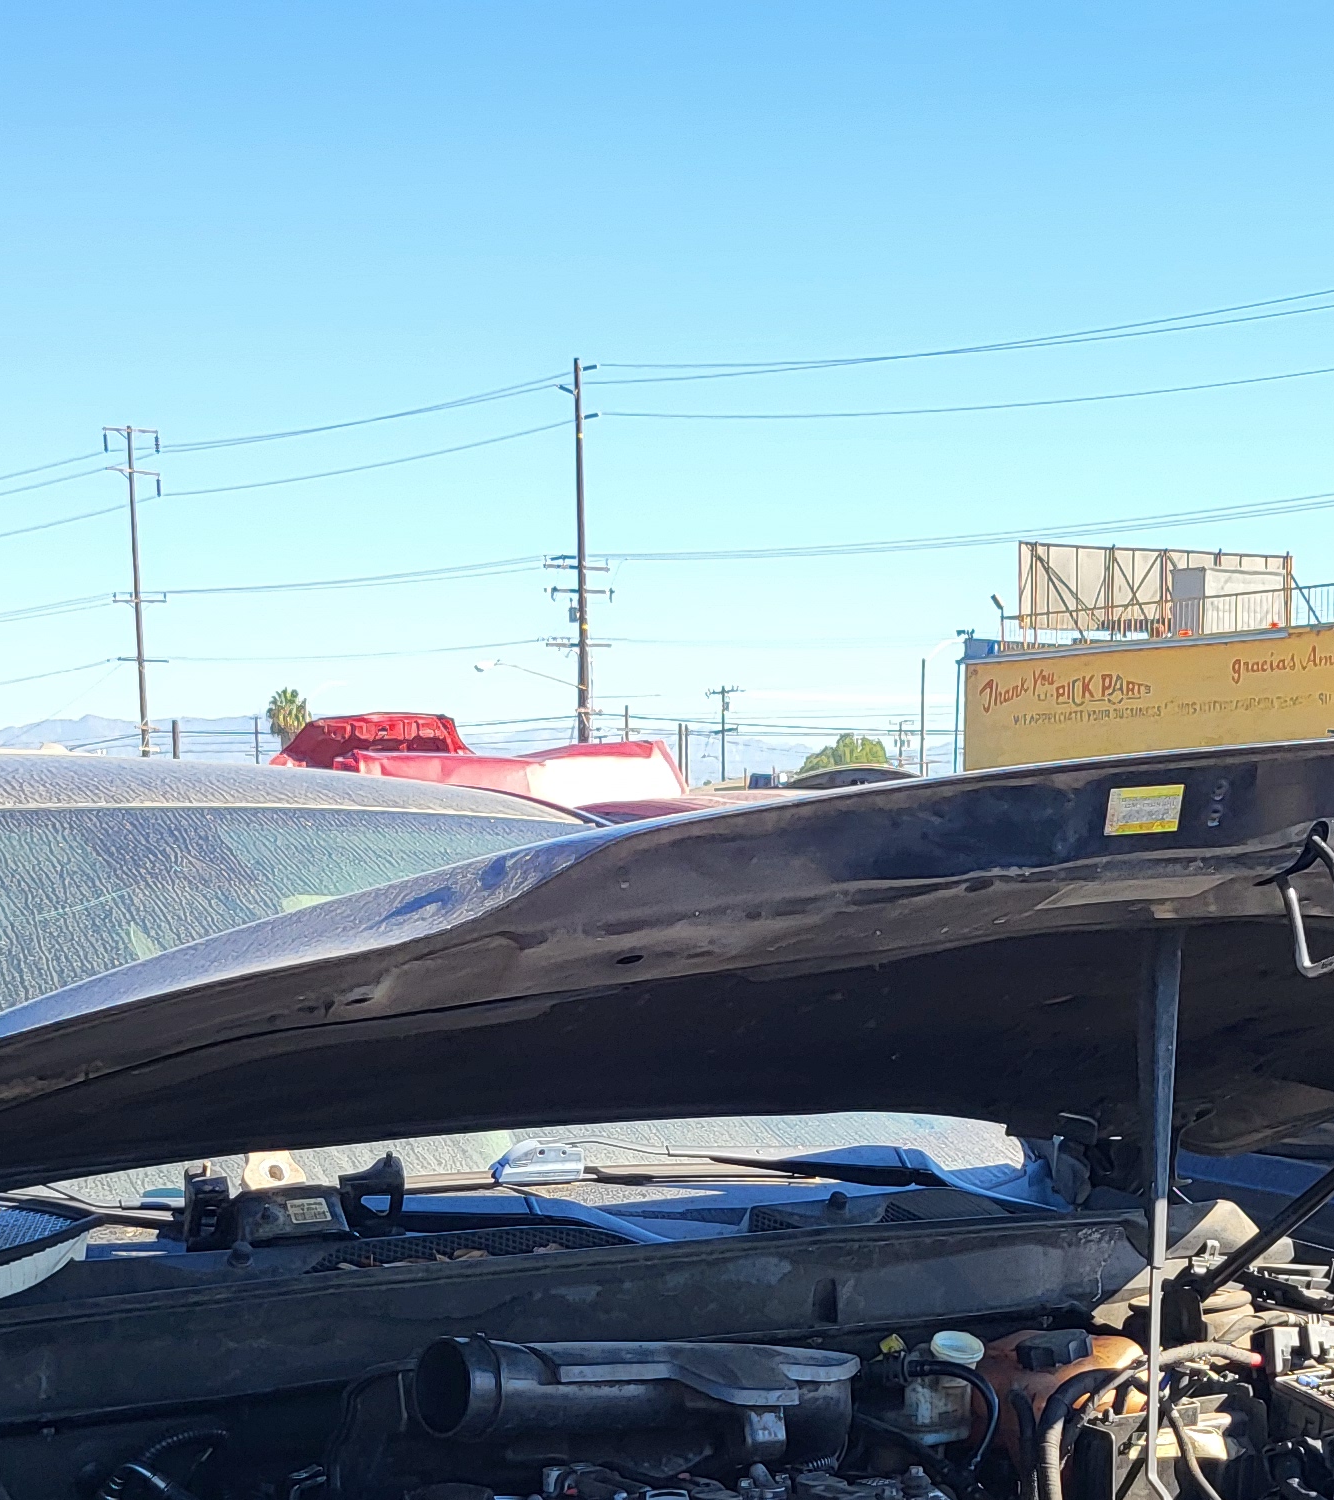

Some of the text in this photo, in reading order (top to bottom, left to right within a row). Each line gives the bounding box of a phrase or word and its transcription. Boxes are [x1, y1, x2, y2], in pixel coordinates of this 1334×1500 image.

[1231, 652, 1296, 684] gracias
[979, 668, 1055, 714] Thank You
[1037, 674, 1095, 707] U-PICK
